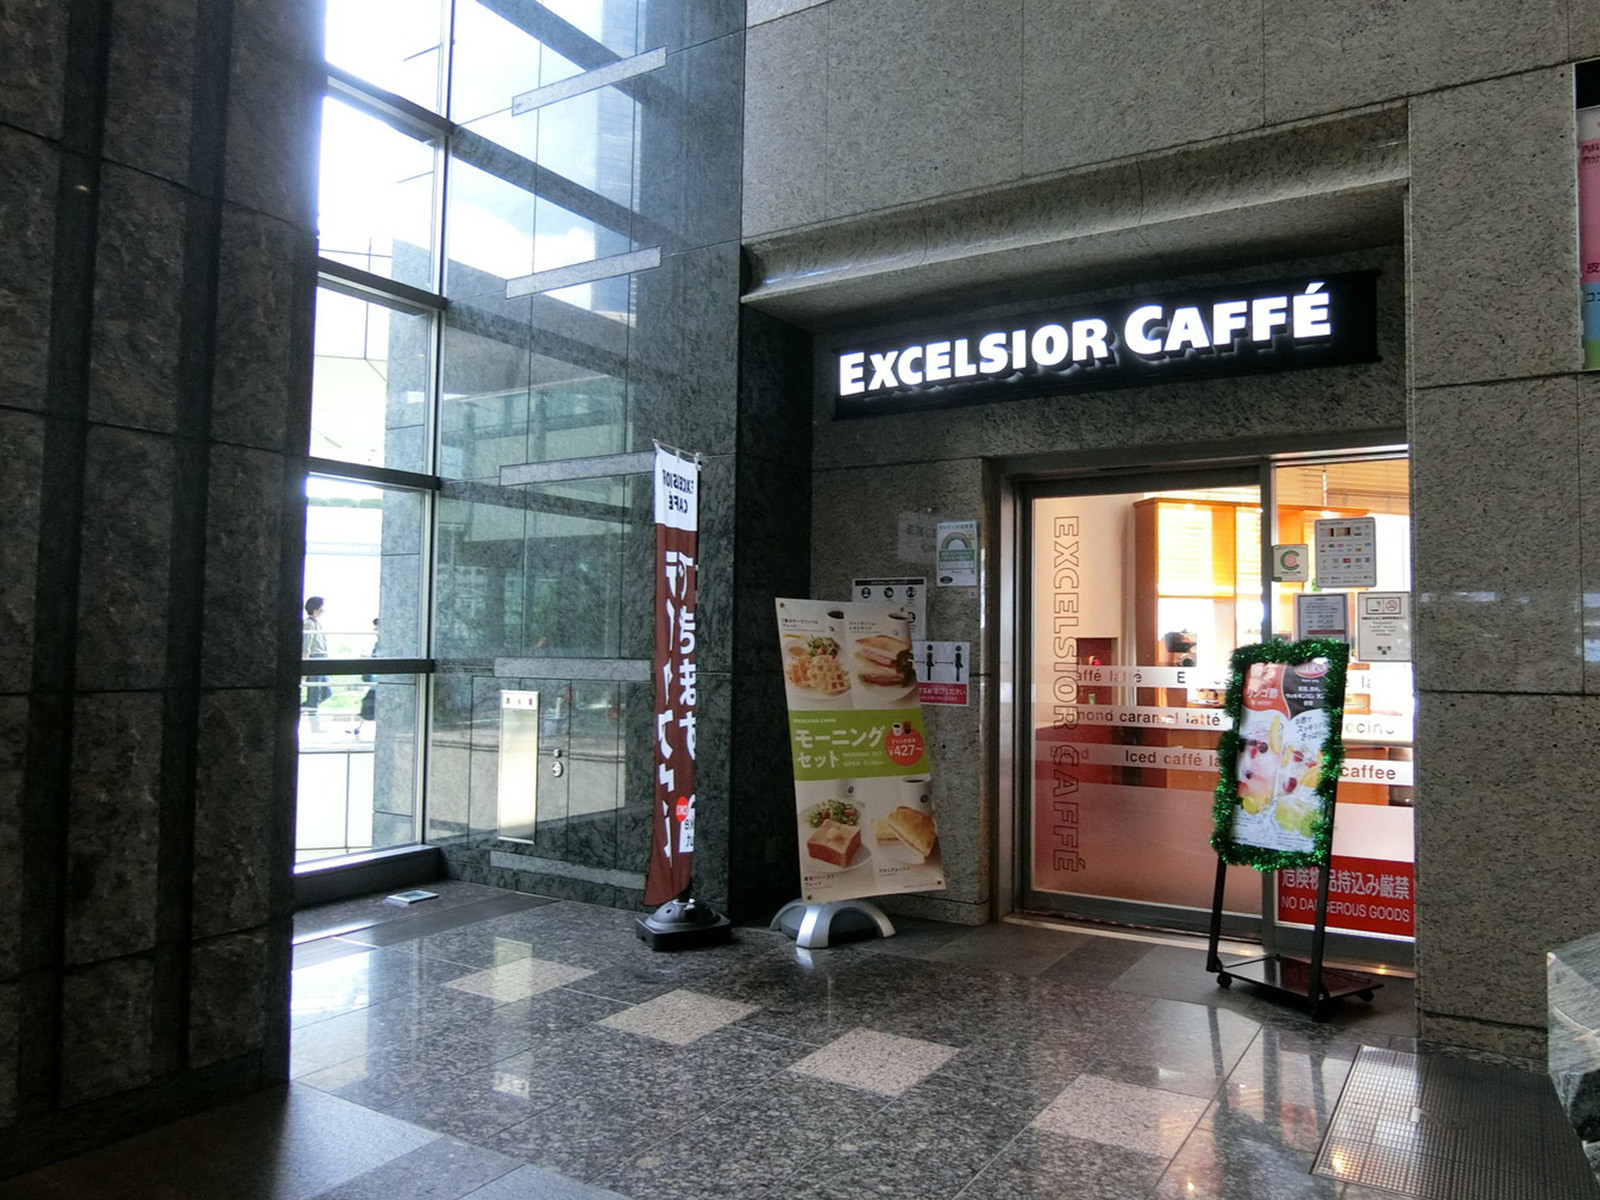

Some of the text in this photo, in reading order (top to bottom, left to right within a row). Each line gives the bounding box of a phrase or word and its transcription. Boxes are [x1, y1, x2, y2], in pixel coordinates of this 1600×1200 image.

[838, 282, 1332, 398] EXCELSIOR CAFFÉ
[1053, 515, 1086, 873] EXCELSIOR CAFFÉ
[795, 725, 886, 748] モーニング
[797, 750, 839, 768] セット
[1125, 750, 1156, 764] Iced
[1164, 753, 1202, 767] caffé
[1341, 764, 1396, 780] caffee
[1282, 867, 1410, 900] 危険物品持込み厳禁
[1281, 896, 1297, 909] NO
[1369, 905, 1411, 923] GOODS
